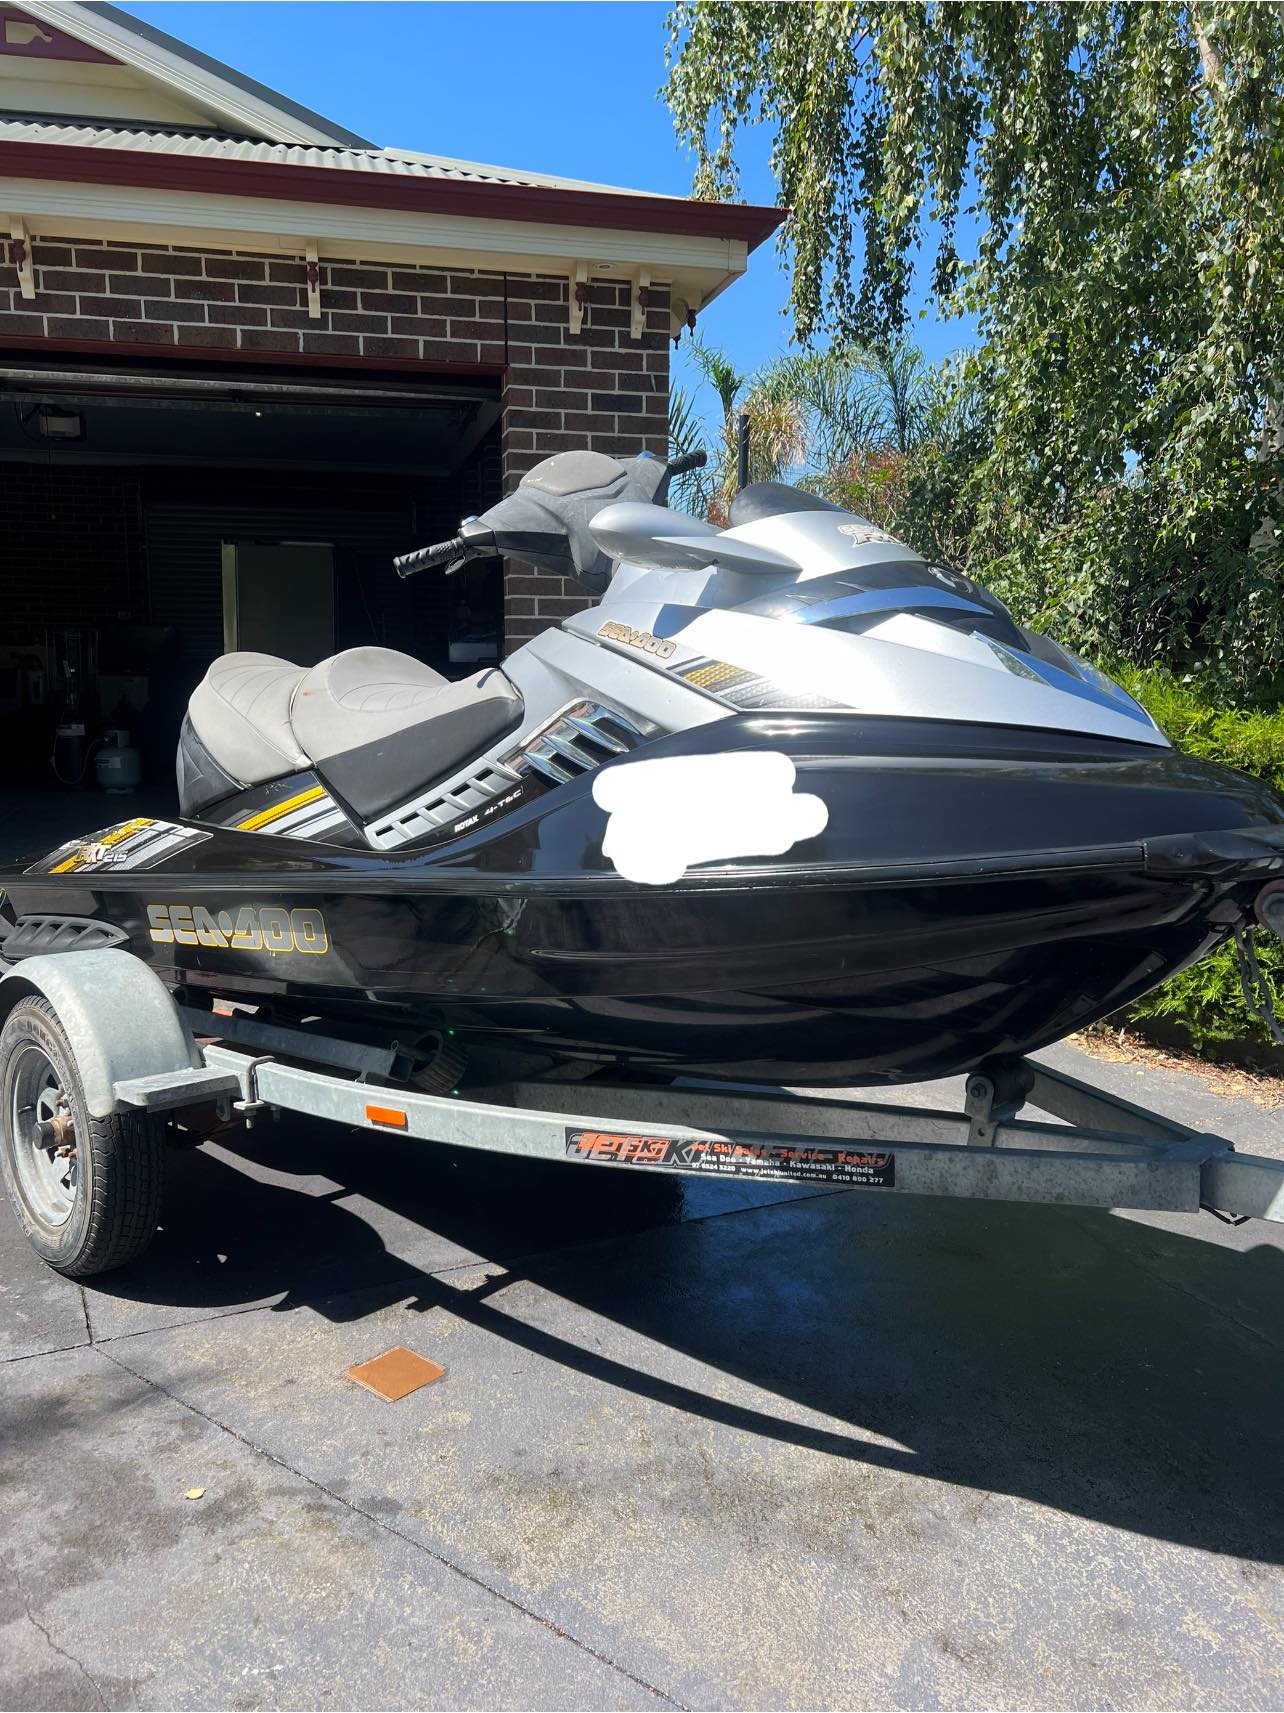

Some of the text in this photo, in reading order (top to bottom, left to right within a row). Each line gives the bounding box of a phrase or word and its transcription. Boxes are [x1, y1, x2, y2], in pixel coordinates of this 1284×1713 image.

[454, 814, 480, 833] ROTAX
[103, 850, 129, 863] 215
[700, 1153, 717, 1162] Sea
[720, 1154, 736, 1163] Doo
[745, 1156, 780, 1166] Yamaha
[789, 1161, 835, 1171] Kawasaki
[845, 1165, 874, 1174] Honda
[714, 1143, 732, 1153] Ski
[780, 1150, 825, 1161] Service
[838, 1152, 884, 1165] Repairs
